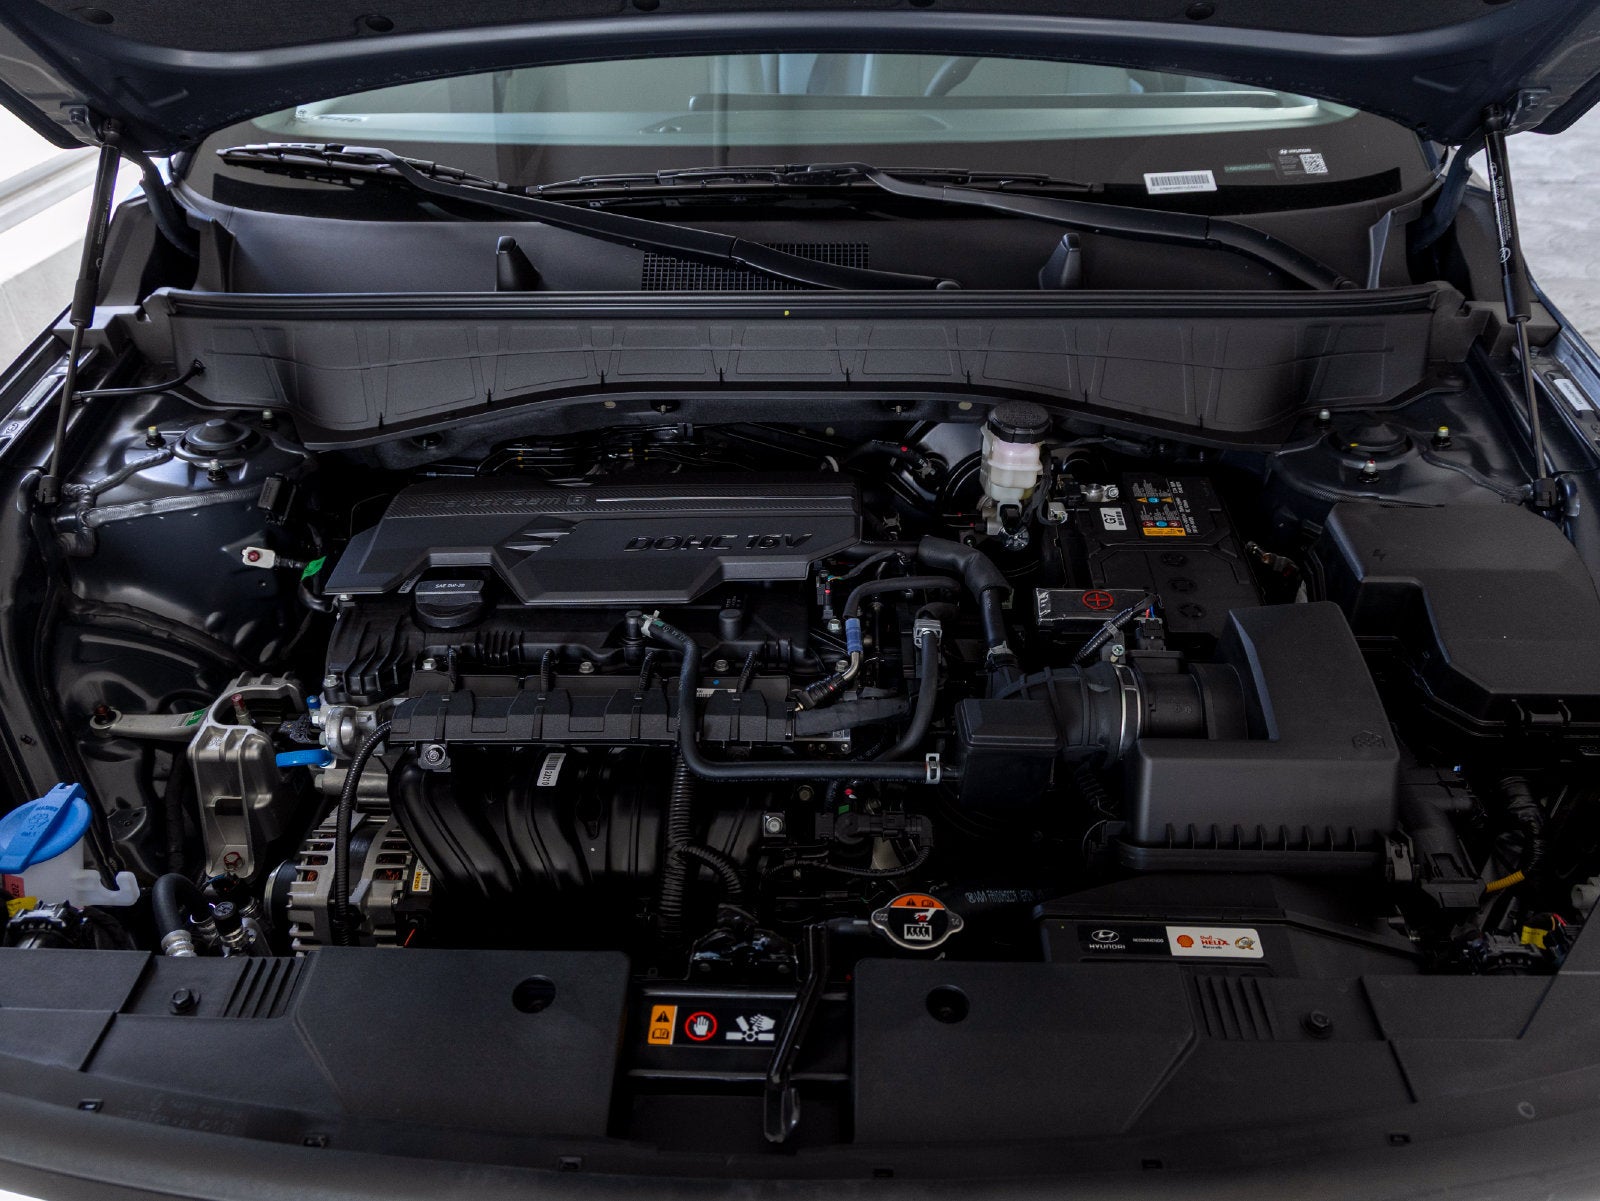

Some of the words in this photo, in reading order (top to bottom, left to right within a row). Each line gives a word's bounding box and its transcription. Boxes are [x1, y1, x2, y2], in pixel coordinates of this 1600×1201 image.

[1104, 513, 1117, 524] G7
[624, 534, 738, 552] DOHC
[746, 533, 812, 549] 16V
